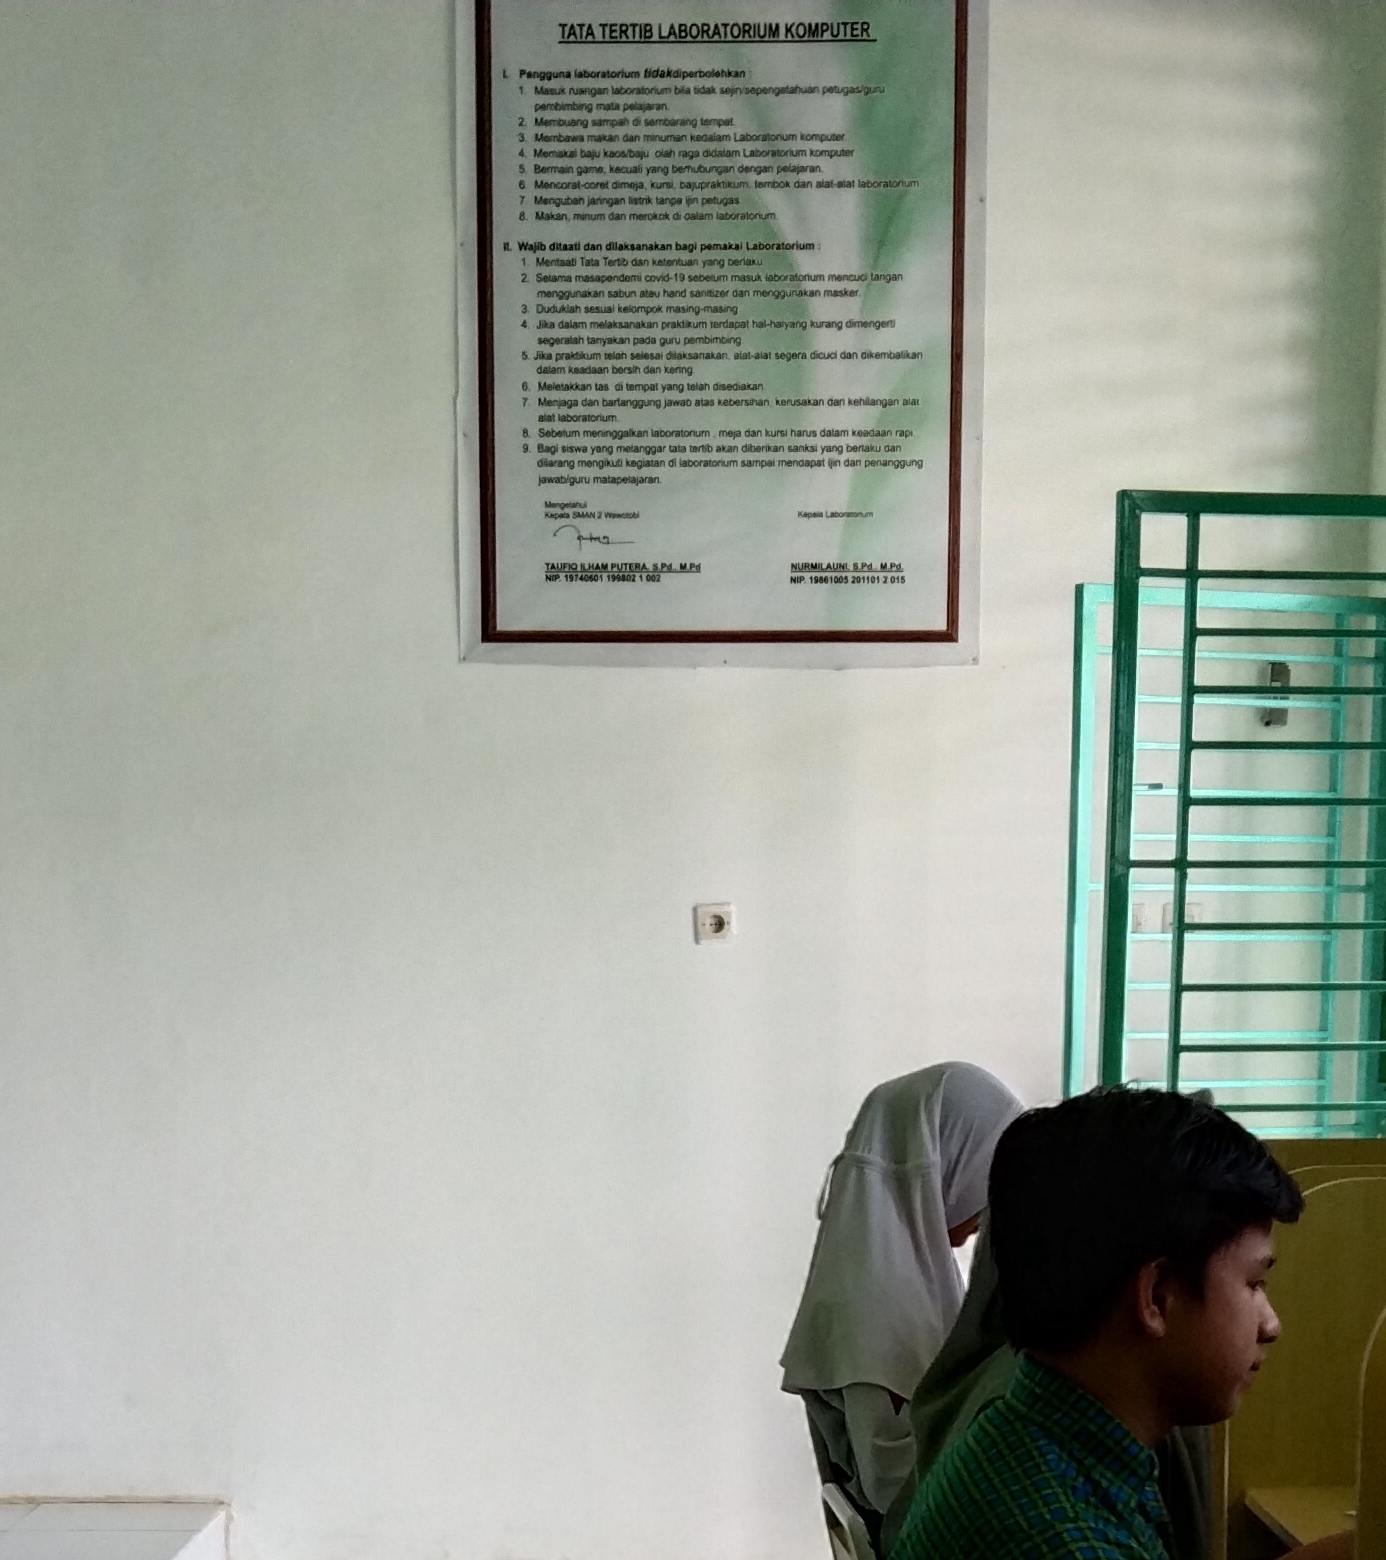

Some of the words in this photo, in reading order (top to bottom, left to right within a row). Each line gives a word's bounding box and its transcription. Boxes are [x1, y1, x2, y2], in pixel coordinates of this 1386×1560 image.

[559, 23, 595, 39] TATA
[599, 23, 653, 39] TERTIB
[658, 22, 780, 39] LABORATORIUM
[785, 21, 871, 39] KOMPUTER
[574, 68, 640, 78] laboratorium
[534, 85, 566, 95] Masuk
[569, 87, 608, 96] ruangan
[611, 85, 671, 95] laboratorium
[694, 85, 716, 95] tidak
[534, 102, 593, 113] pembimbing
[596, 102, 620, 111] mata
[534, 118, 588, 128] Membuang
[591, 118, 630, 128] sampah
[643, 118, 697, 128] sembarang
[534, 133, 584, 142] Membawa
[587, 133, 620, 142] makan
[622, 133, 640, 141] dan
[643, 133, 687, 141] minuman
[733, 132, 797, 141] Laboratorium
[533, 149, 578, 158] Memakai
[580, 149, 600, 159] baju
[603, 149, 649, 159] kaos/baju
[678, 150, 699, 159] raga
[702, 148, 740, 157] didalam
[743, 148, 807, 157] Laboratorium
[534, 164, 574, 174] Bermain
[609, 164, 643, 174] kecuali
[645, 166, 669, 175] yang
[737, 164, 773, 175] dengan
[754, 179, 791, 188] tembok
[794, 179, 813, 188] dan
[815, 178, 855, 187] alat-alat
[534, 196, 584, 207] Mengubah
[587, 196, 626, 206] jaringan
[628, 196, 652, 205] listrik
[655, 196, 683, 206] tanpa
[573, 211, 605, 220] minum
[608, 211, 627, 220] dan
[629, 211, 670, 220] merokok
[684, 211, 713, 219] dalam
[517, 242, 546, 253] Wajib
[549, 242, 581, 251] ditaati
[584, 242, 603, 251] dan
[605, 241, 672, 251] dilaksanakan
[675, 241, 697, 252] bagi
[700, 241, 742, 252] pemakai
[746, 241, 815, 250] Laboratorium
[579, 257, 600, 266] Tata
[603, 257, 628, 266] Tertib
[631, 257, 649, 266] dan
[652, 257, 699, 266] ketentuan
[701, 259, 725, 268] yang
[535, 272, 572, 282] Selama
[645, 273, 685, 282] covid-19
[688, 273, 728, 282] sebelum
[730, 273, 762, 282] masuk
[765, 273, 825, 282] laboratorium
[828, 273, 867, 282] mencuci
[870, 273, 903, 283] tangan
[536, 289, 605, 300] menggunakan
[607, 288, 637, 298] sabun
[639, 288, 660, 298] atau
[663, 288, 687, 298] hand
[732, 288, 750, 298] dan
[752, 288, 821, 299] menggunakan
[535, 304, 581, 314] Duduklah
[584, 304, 615, 314] sesuai
[617, 304, 663, 315] kelompok
[535, 320, 555, 329] Jika
[557, 320, 587, 329] dalam
[590, 320, 659, 329] melaksanakan
[661, 320, 707, 330] praktikum
[709, 320, 749, 330] terdapat
[810, 319, 843, 330] kurang
[537, 336, 584, 347] segeralah
[587, 336, 630, 347] tanyakan
[633, 336, 656, 346] pada
[659, 338, 680, 346] guru
[555, 351, 601, 362] praktikum
[604, 351, 627, 360] telah
[630, 351, 663, 360] selesai
[774, 353, 807, 362] segera
[810, 351, 837, 360] dicuci
[840, 351, 858, 360] dan
[860, 351, 923, 360] dikembalikan
[536, 365, 565, 375] dalam
[568, 365, 609, 374] keadaan
[611, 365, 640, 374] bersih
[643, 365, 661, 374] dan
[594, 382, 609, 392] tas
[626, 382, 659, 393] tempat
[661, 384, 684, 393] yang
[686, 382, 710, 391] telah
[537, 398, 579, 409] Menjaga
[581, 398, 599, 407] dan
[663, 397, 692, 409] jawab
[694, 397, 715, 407] atas
[775, 397, 824, 407] kerusakan
[848, 396, 900, 408] kehilangan
[537, 413, 555, 421] alat
[537, 429, 580, 438] Sebelum
[583, 428, 649, 440] meninggalkan
[651, 428, 710, 438] laboratorium
[718, 430, 742, 439] meja
[744, 428, 762, 437] dan
[765, 428, 787, 437] kursi
[790, 428, 817, 437] harus
[820, 428, 849, 437] dalam
[851, 428, 893, 437] keadaan
[537, 444, 559, 455] Bagi
[561, 444, 588, 453] siswa
[590, 446, 614, 455] yang
[616, 444, 666, 455] melanggar
[668, 444, 687, 453] tata
[689, 444, 713, 453] tertib
[715, 444, 738, 453] akan
[741, 444, 784, 453] diberikan
[787, 444, 818, 453] sanksi
[820, 446, 844, 455] yang
[846, 444, 881, 453] berlaku
[884, 444, 901, 453] dan
[625, 459, 665, 470] kegiatan
[668, 459, 676, 468] di
[679, 458, 738, 468] laboratorium
[741, 458, 775, 470] sampai
[777, 458, 825, 469] mendapat
[864, 460, 924, 469] penanggung
